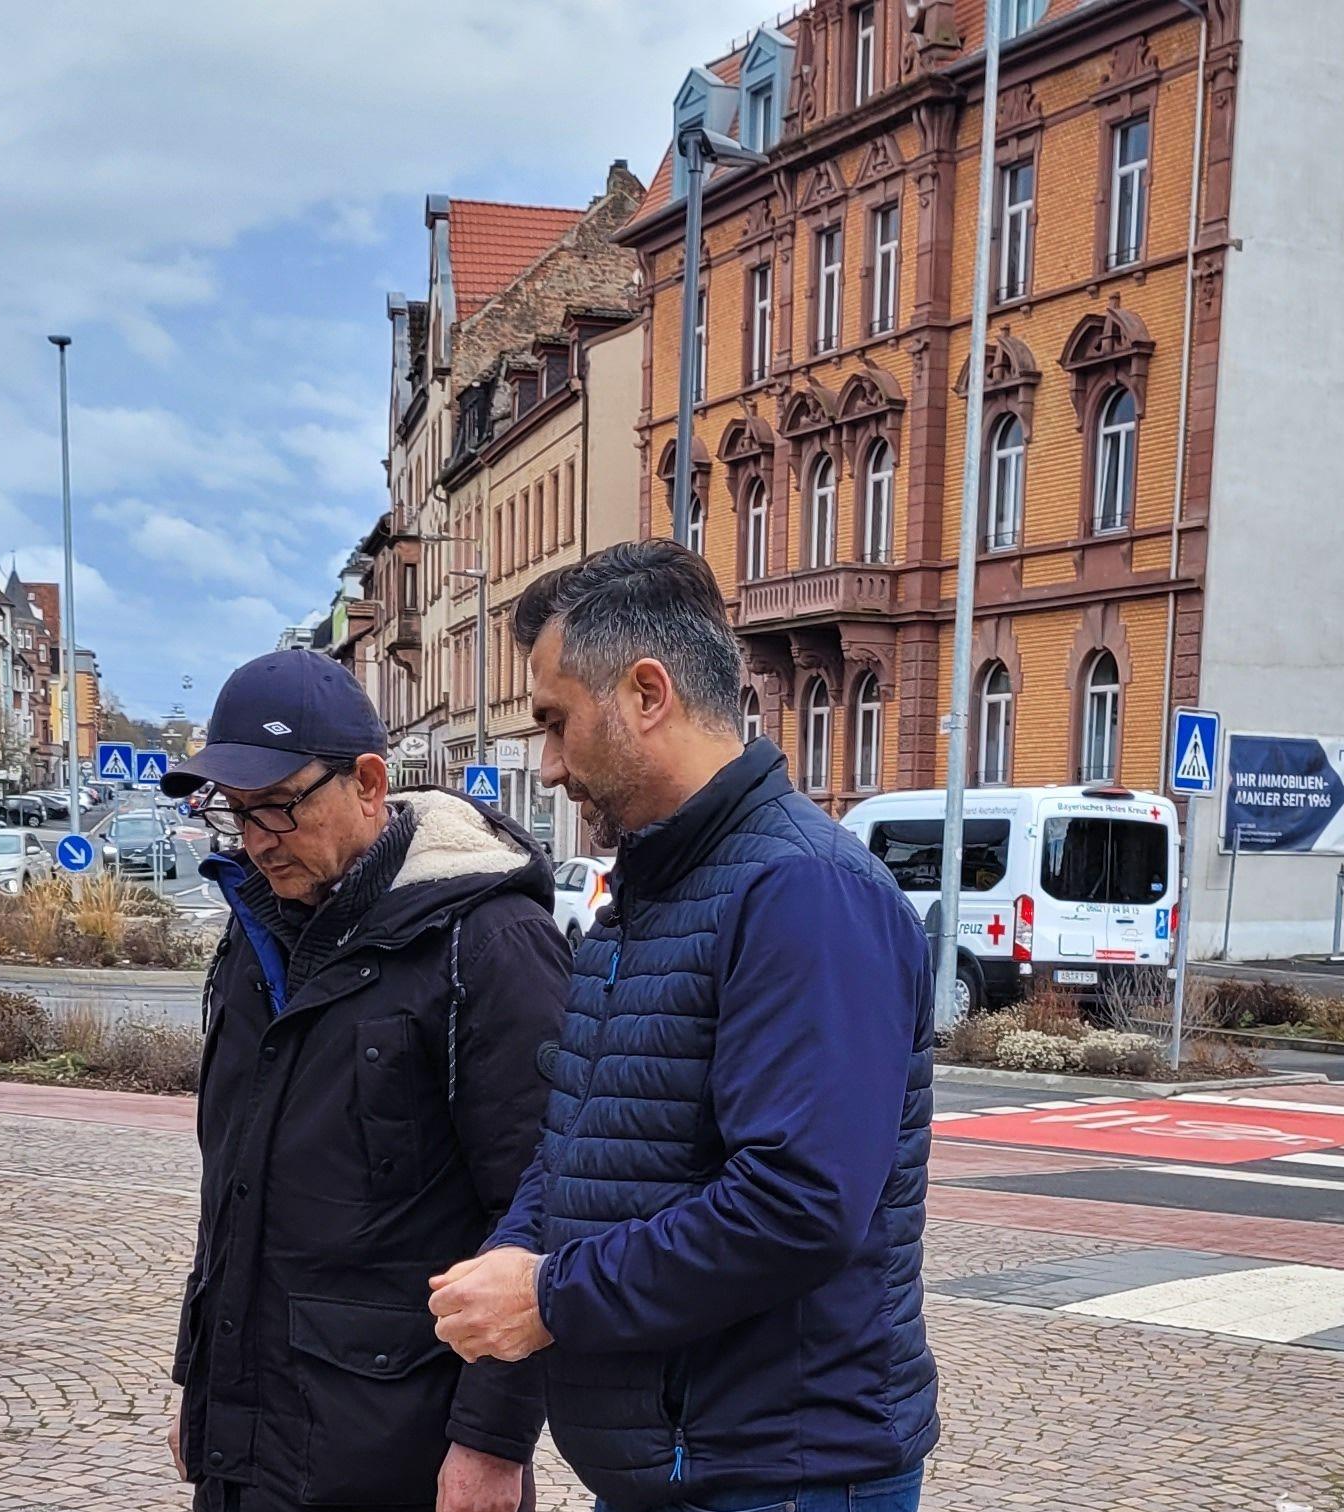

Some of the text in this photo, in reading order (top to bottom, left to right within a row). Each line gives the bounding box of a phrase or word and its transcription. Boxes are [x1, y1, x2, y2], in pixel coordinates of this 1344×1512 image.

[1236, 773, 1329, 790] IHR IMMOBILIEN-
[1235, 791, 1331, 807] MAKLER SEIT 1966
[1057, 803, 1103, 815] Bayerisches
[1128, 806, 1148, 815] Kreuz
[958, 921, 983, 935] reuz
